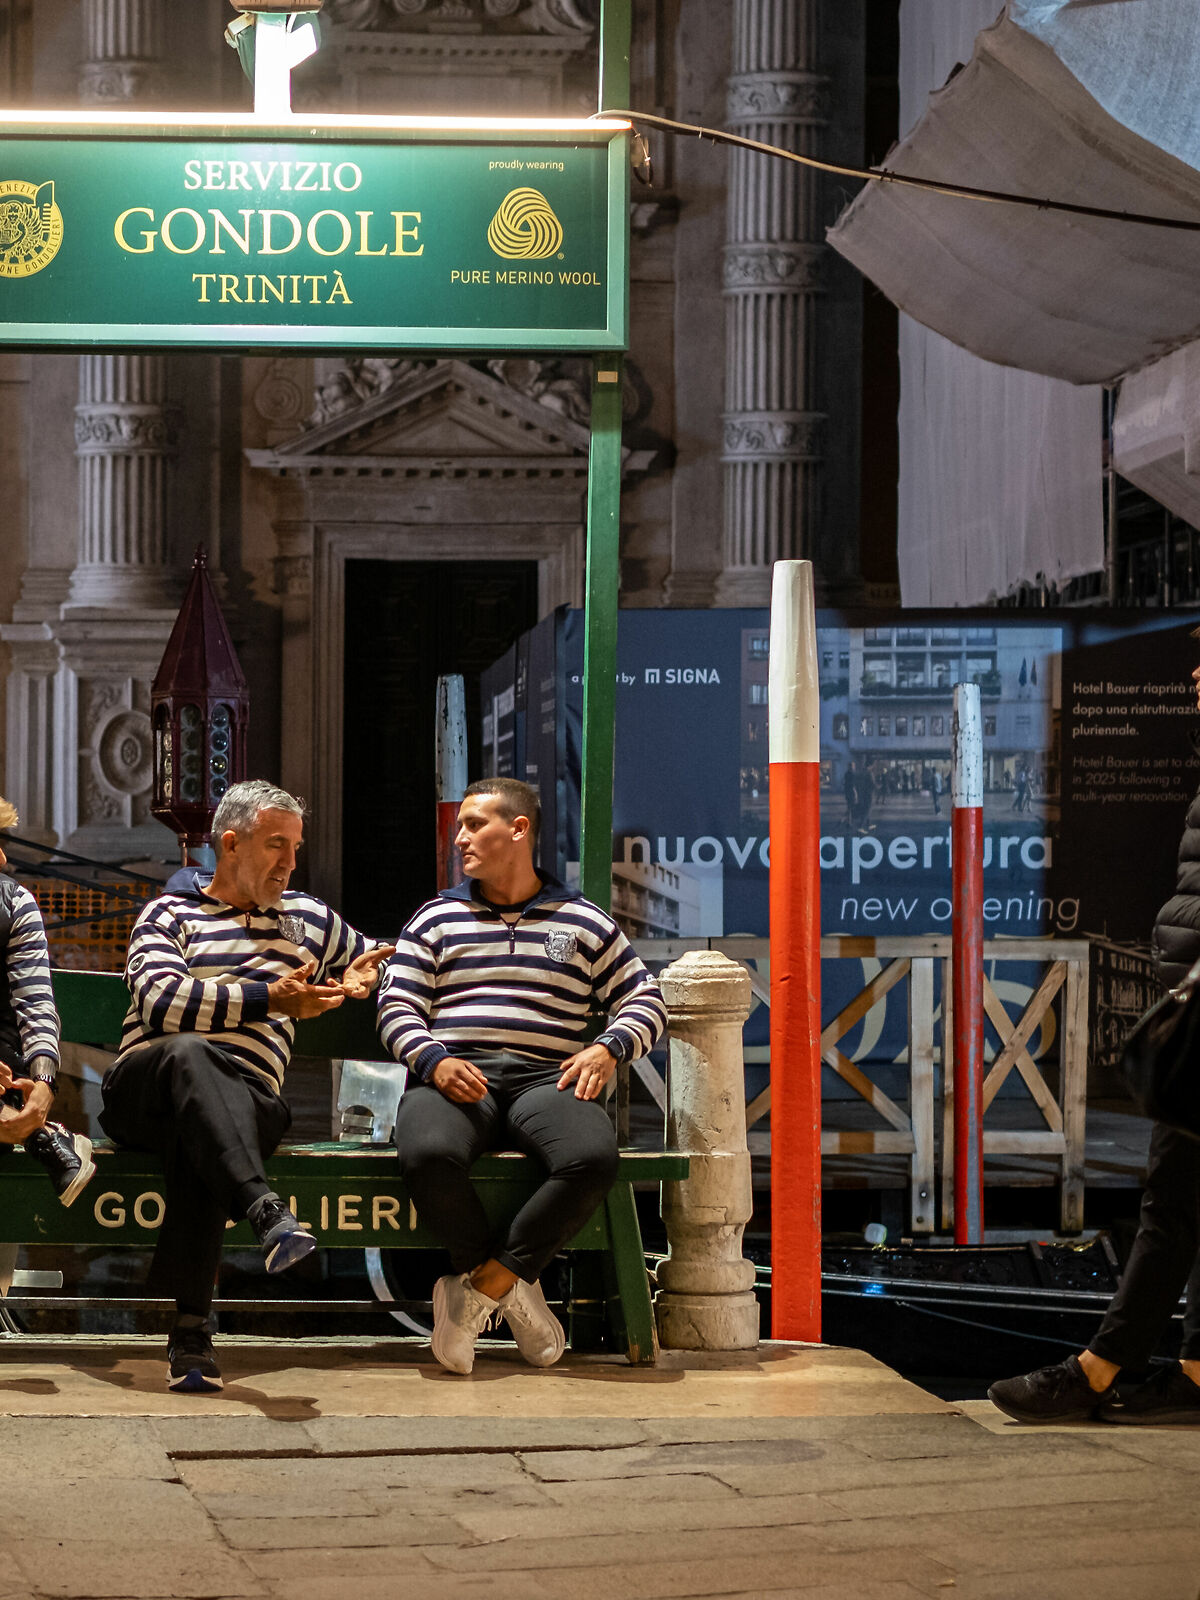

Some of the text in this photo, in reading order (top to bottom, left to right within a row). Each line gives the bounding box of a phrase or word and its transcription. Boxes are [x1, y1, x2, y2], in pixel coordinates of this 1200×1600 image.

[489, 160, 564, 172] proudly wearing
[184, 160, 362, 192] SERVIZIO
[114, 207, 425, 256] GONDOLE
[25, 218, 61, 273] GONDOLIERI
[450, 270, 601, 286] PURE MERINO WOOL
[192, 270, 353, 304] TRINITÀ
[621, 672, 636, 686] by
[665, 668, 721, 684] SIGNA
[1073, 682, 1103, 694] Hotel
[1106, 682, 1140, 694] Bauer
[1143, 682, 1186, 697] riaprirà
[1072, 702, 1103, 718] dopo
[1106, 706, 1128, 715] una
[1072, 723, 1140, 739] pluriennale.
[1073, 756, 1103, 768] Hotel
[1106, 756, 1139, 768] Bauer
[1085, 772, 1116, 785] 2025
[1119, 772, 1170, 787] following
[840, 890, 1080, 931] new oening
[94, 1191, 418, 1232] GOLIERI
